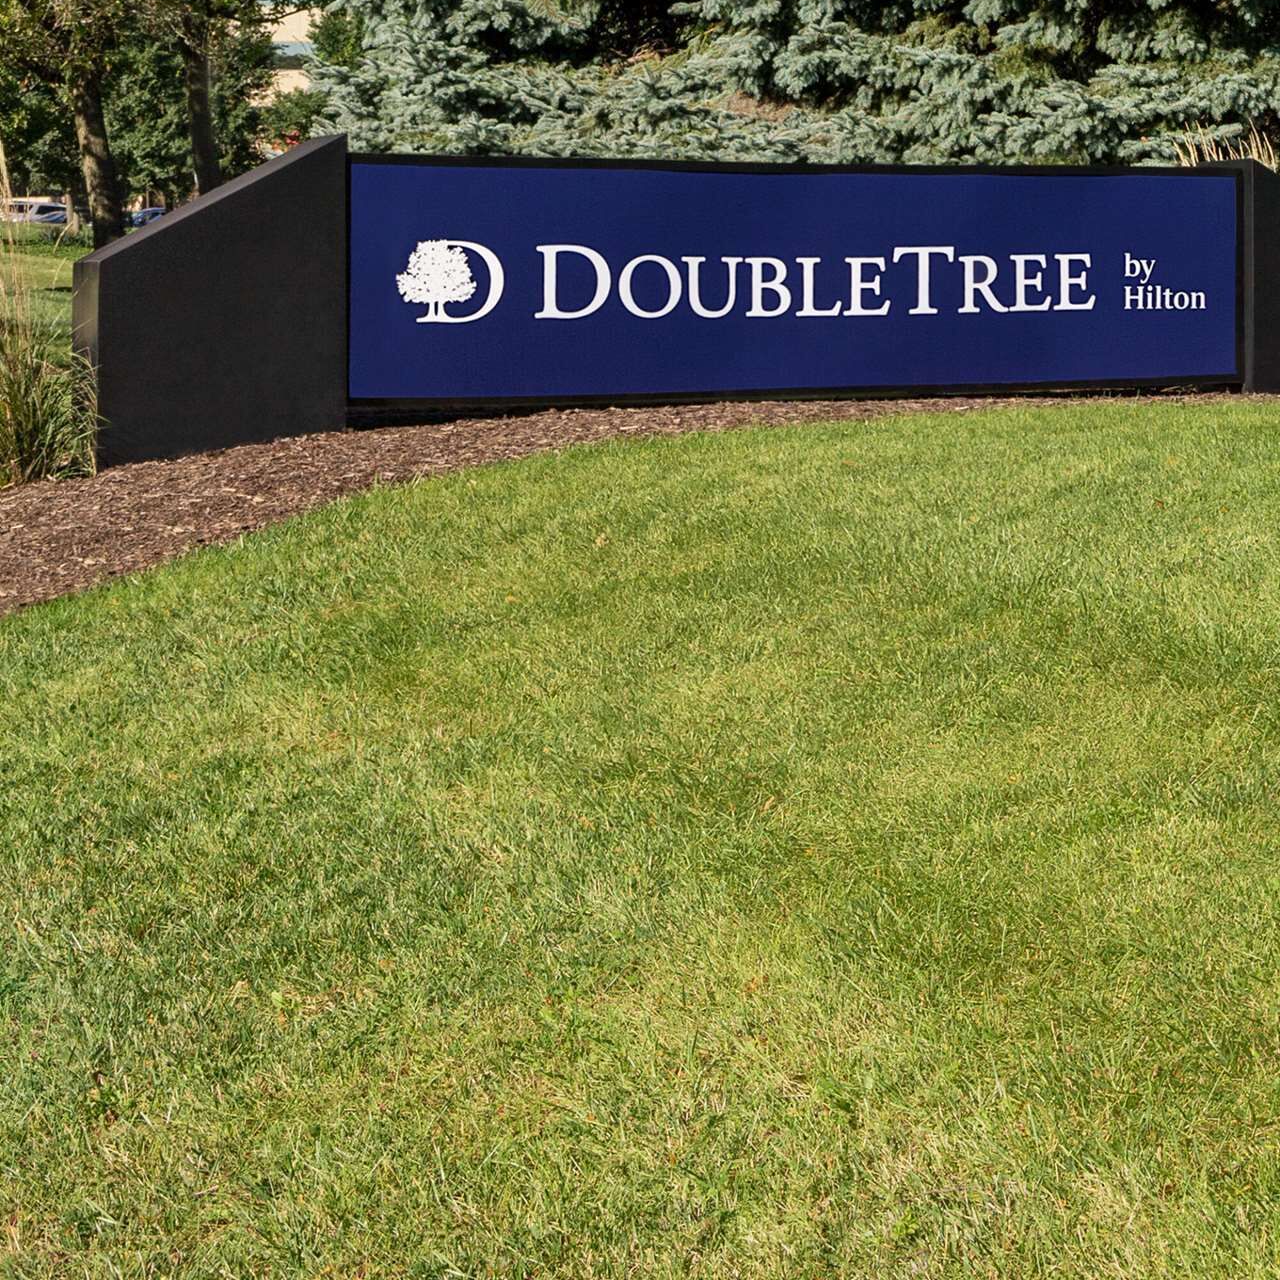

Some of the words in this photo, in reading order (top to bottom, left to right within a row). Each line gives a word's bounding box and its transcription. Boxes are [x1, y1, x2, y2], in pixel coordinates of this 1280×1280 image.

[534, 244, 1096, 320] DOUBLETREE
[1124, 252, 1156, 285] by
[1123, 284, 1206, 310] Hilton
